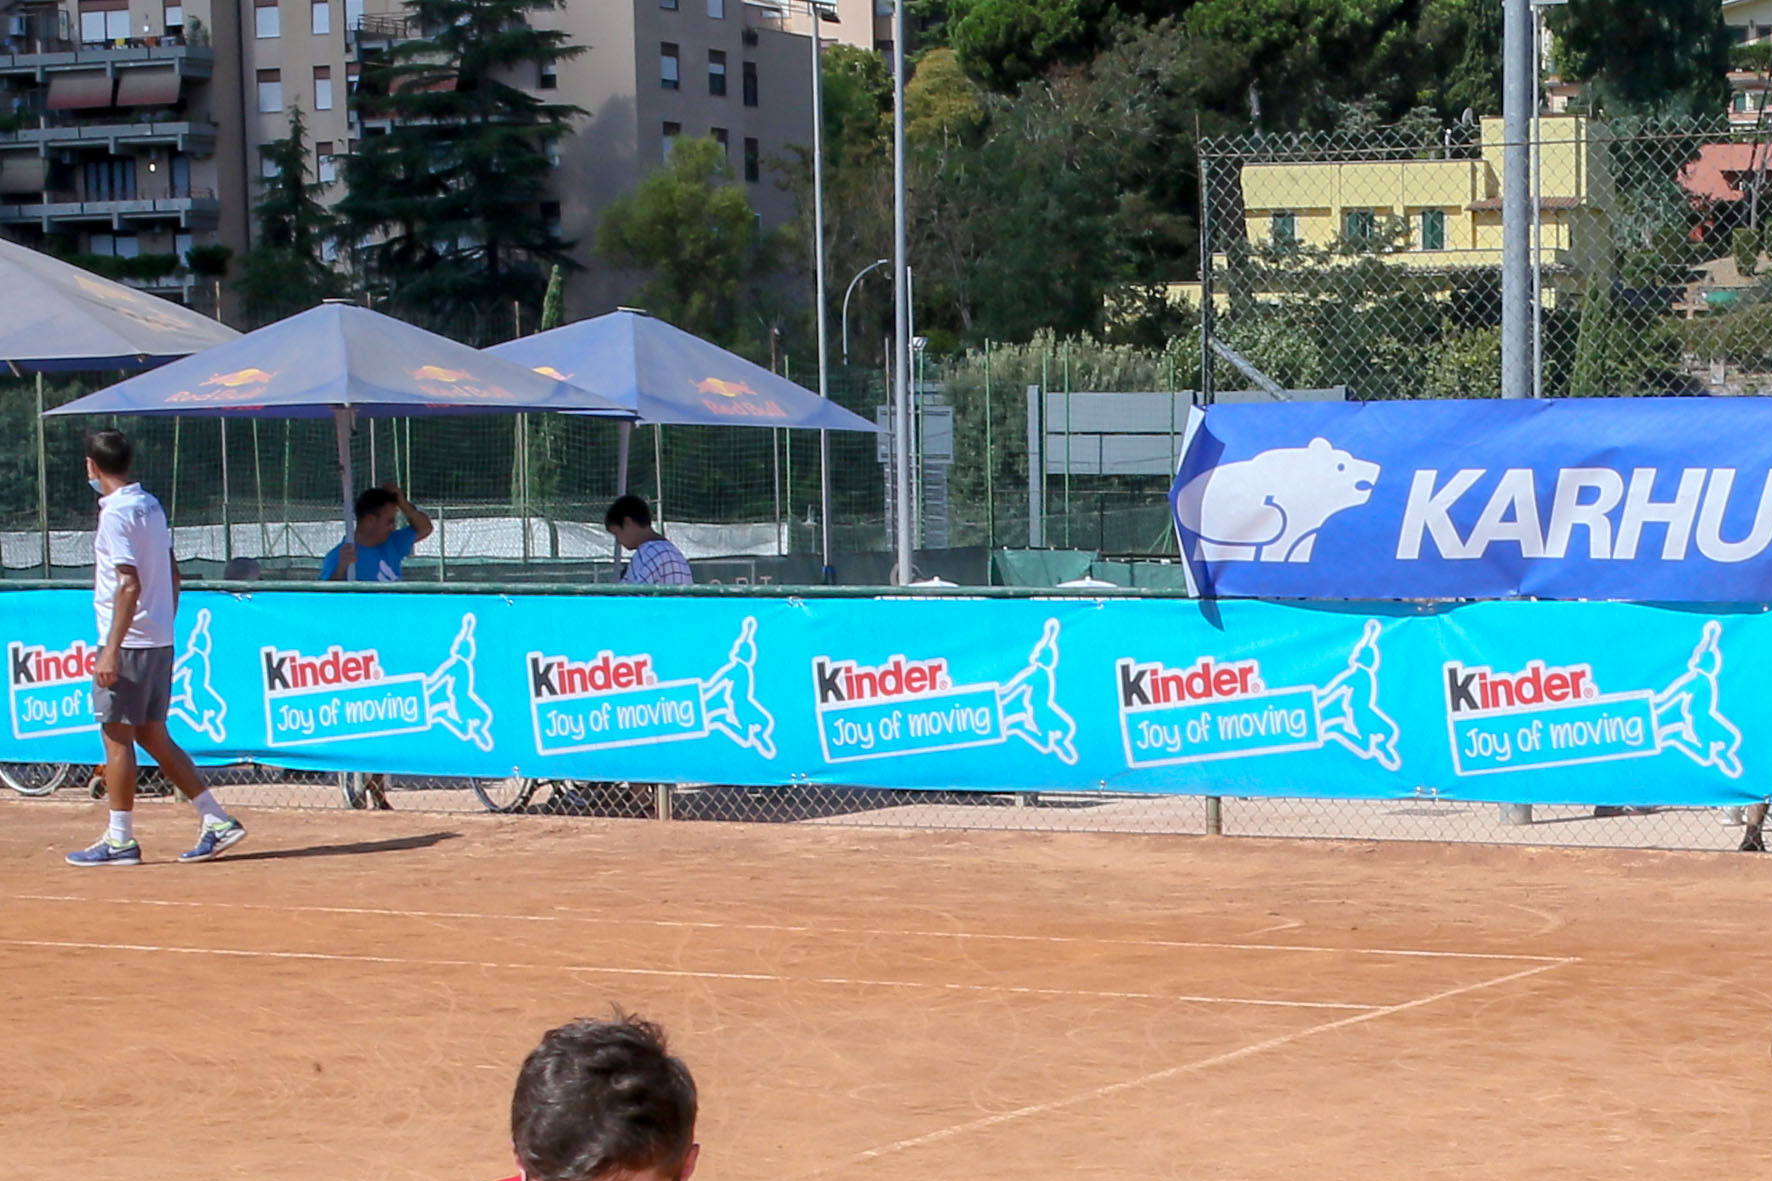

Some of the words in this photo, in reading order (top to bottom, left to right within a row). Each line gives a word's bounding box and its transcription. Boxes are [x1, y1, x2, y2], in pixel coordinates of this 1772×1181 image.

[22, 696, 57, 725] Joy
[62, 689, 83, 717] of
[278, 705, 314, 735] Joy
[319, 697, 341, 727] of
[345, 696, 418, 723] moving
[545, 710, 585, 741] Joy
[589, 702, 611, 732] of
[616, 700, 694, 729] moving
[832, 718, 874, 749] Joy
[879, 710, 902, 741] of
[908, 706, 990, 737] moving
[1136, 720, 1181, 752] Joy
[1186, 711, 1212, 744] of
[1217, 704, 1308, 740] moving
[1464, 727, 1511, 762] Joy
[1517, 719, 1543, 752] of
[1549, 712, 1643, 749] moving
